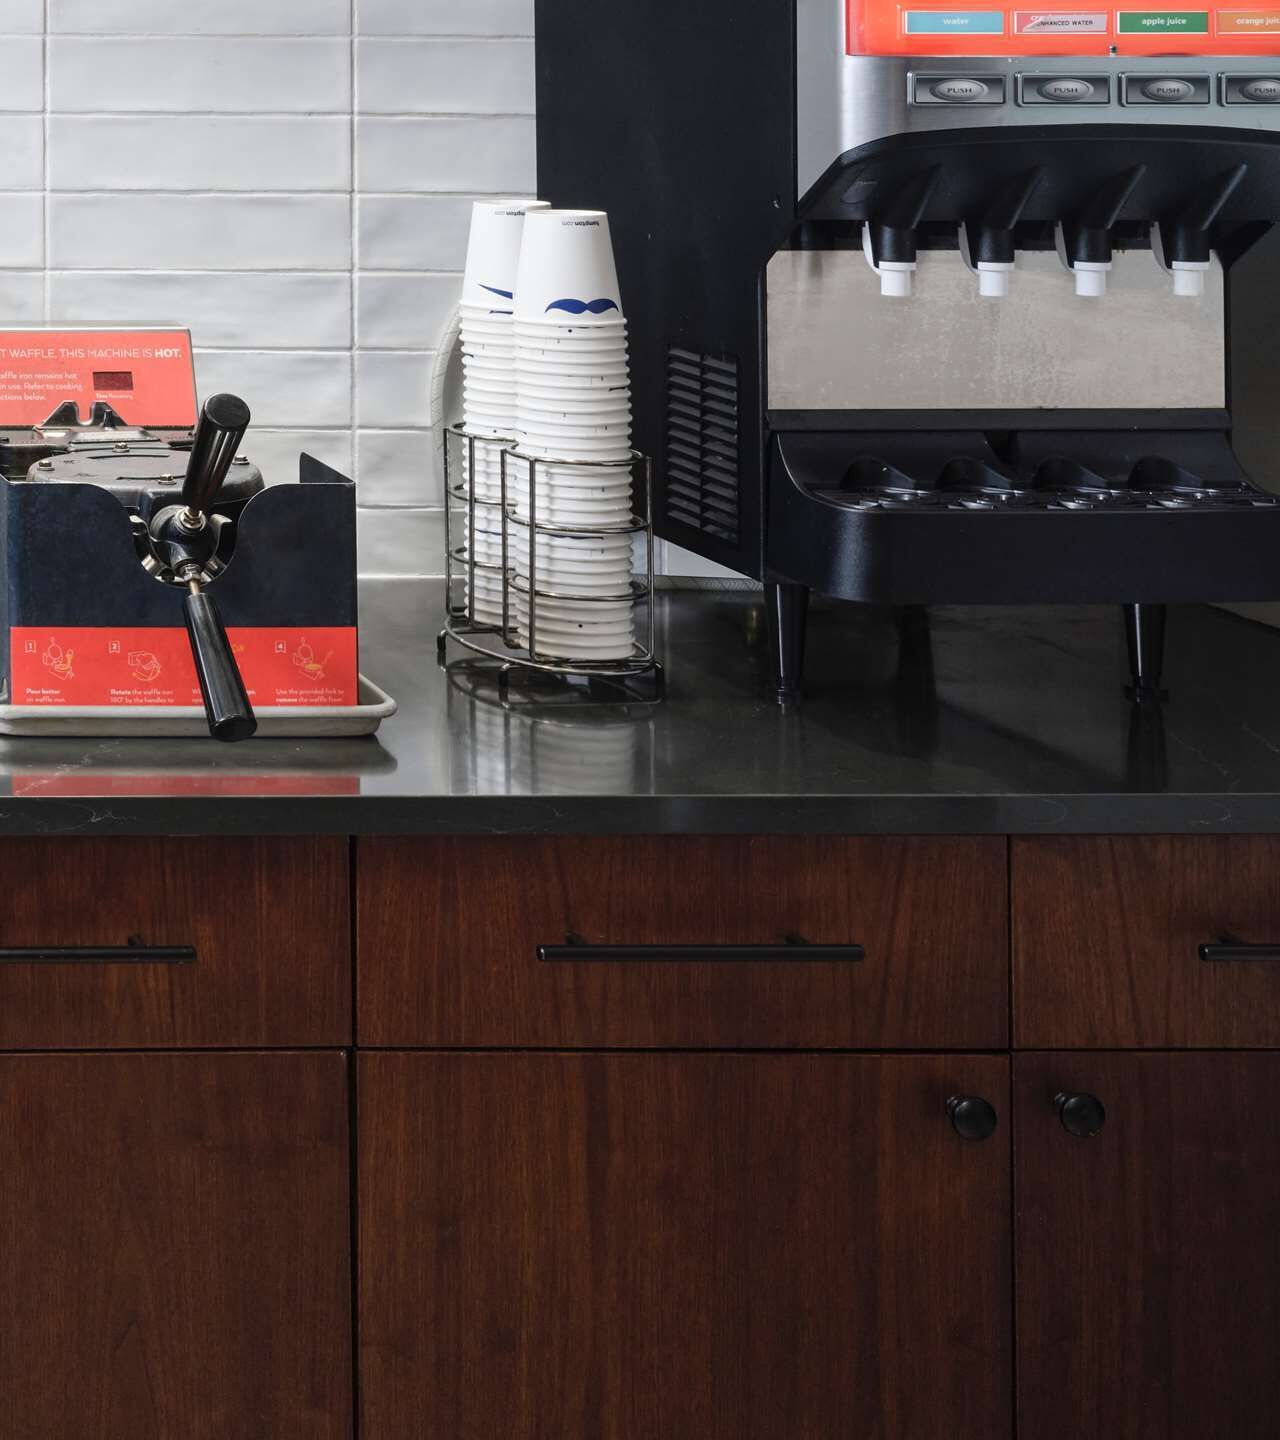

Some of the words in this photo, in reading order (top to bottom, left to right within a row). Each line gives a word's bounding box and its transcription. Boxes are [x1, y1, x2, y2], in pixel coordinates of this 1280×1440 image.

[942, 17, 970, 26] water
[1142, 16, 1165, 28] apple
[1167, 16, 1188, 28] juice
[1236, 17, 1264, 27] orange
[60, 348, 85, 359] THIS
[88, 348, 139, 359] MACHINE
[142, 348, 153, 359] IS
[155, 348, 182, 359] HOT.
